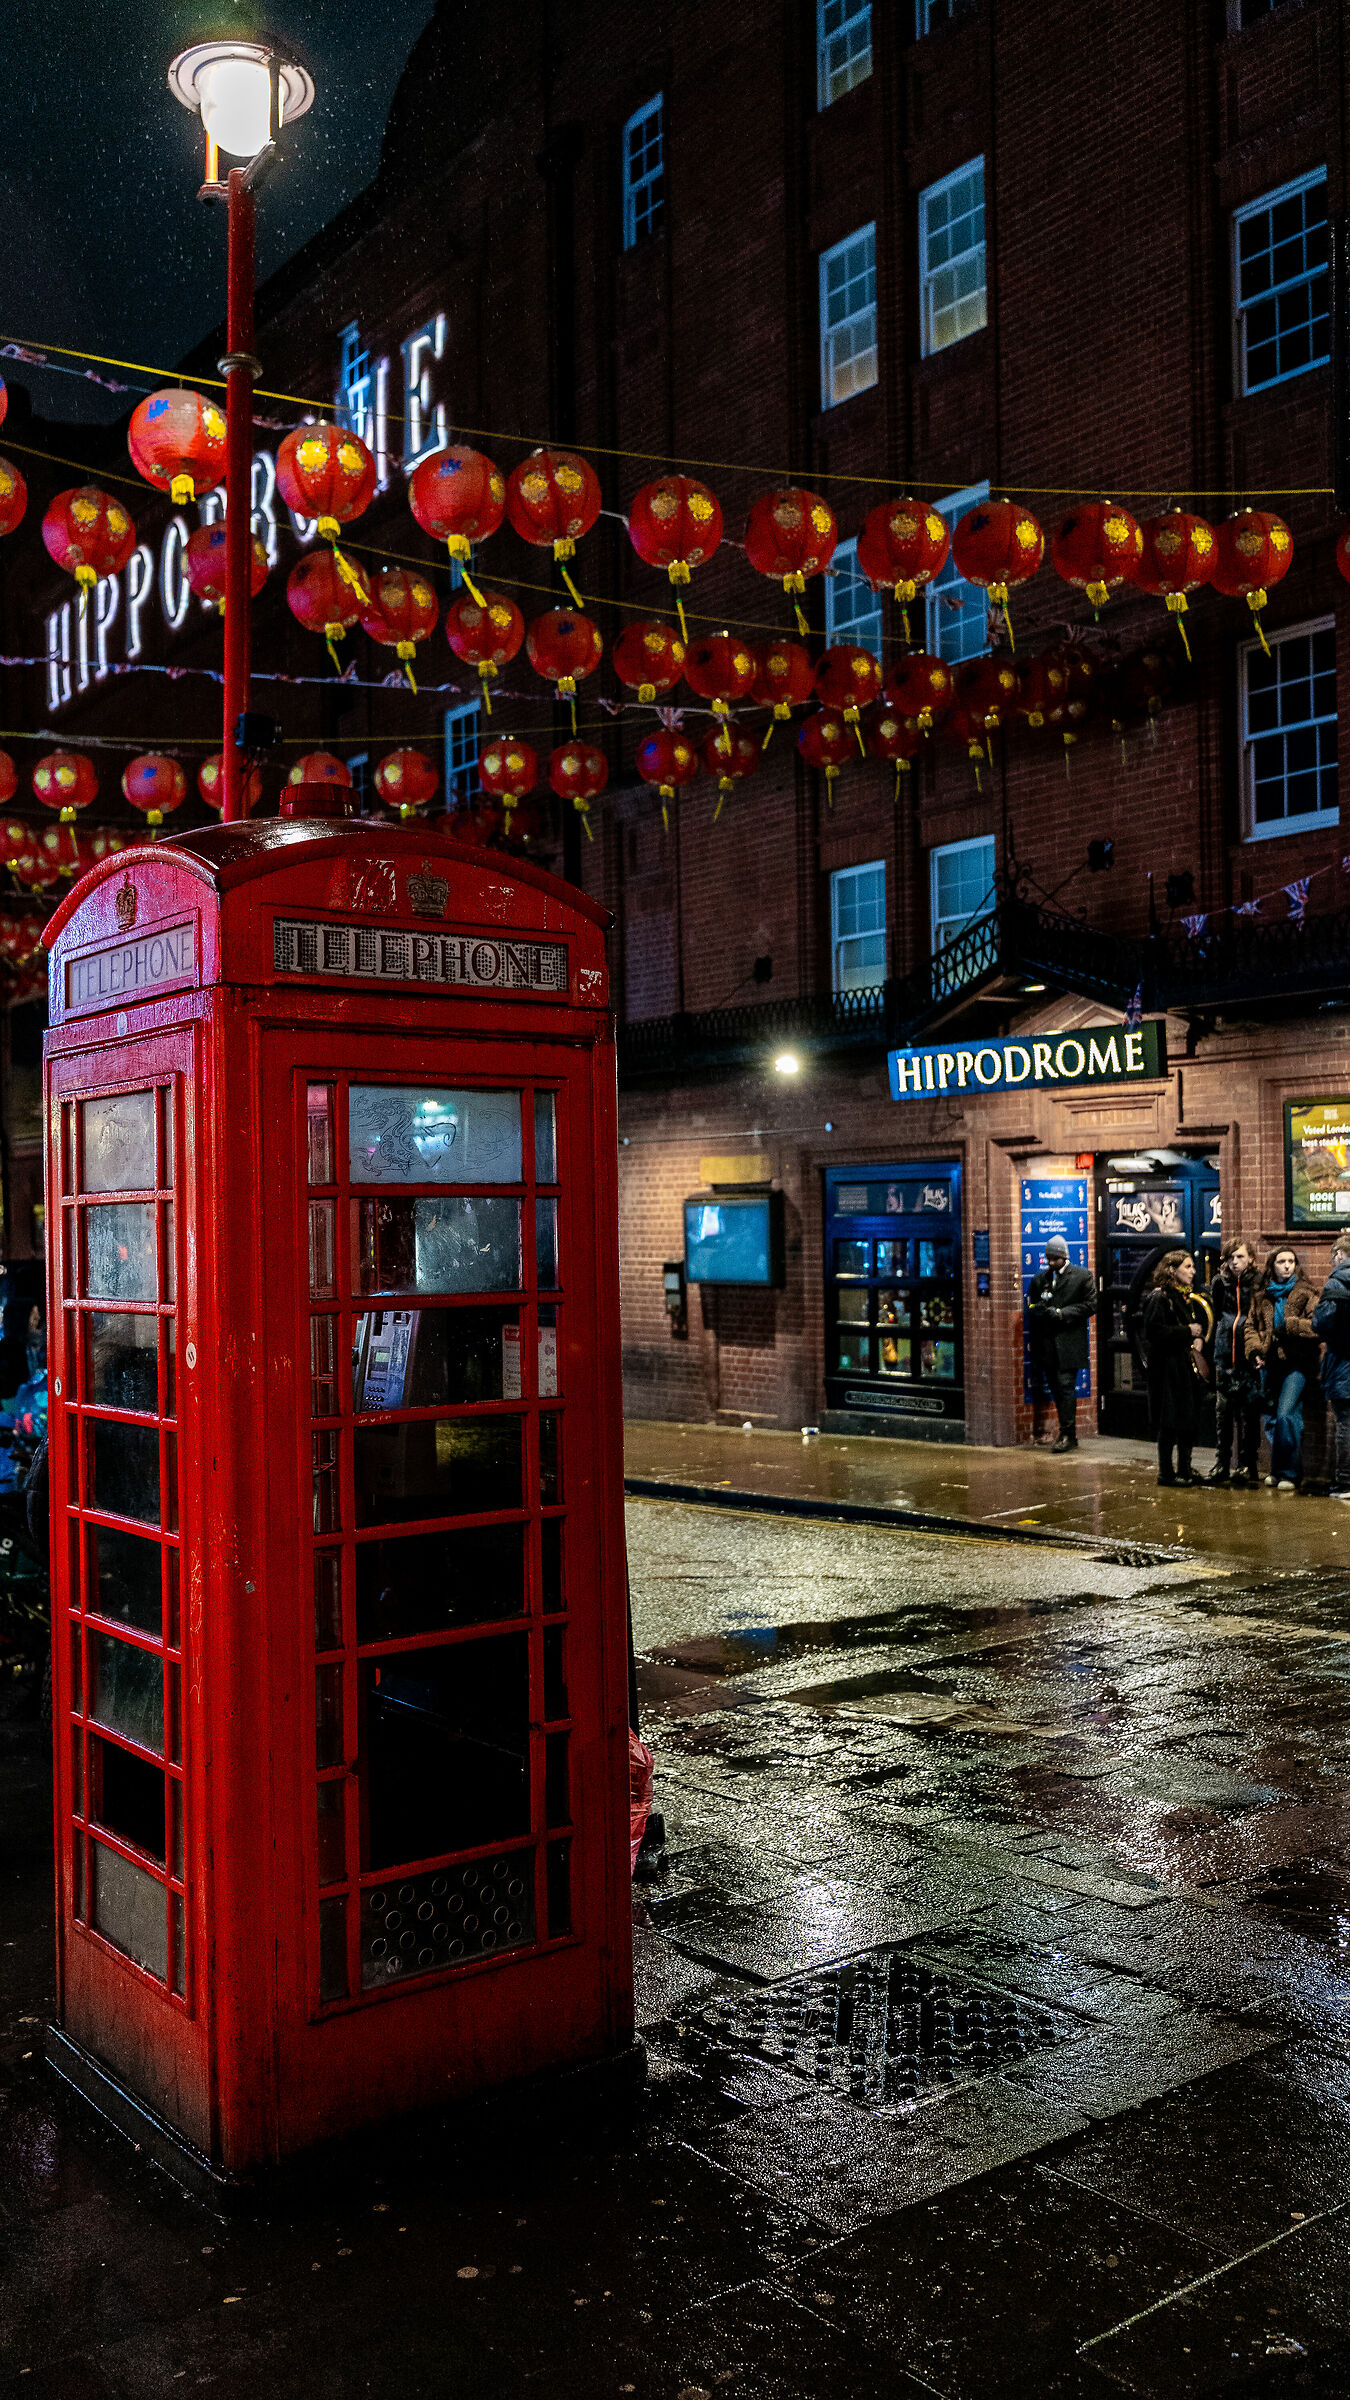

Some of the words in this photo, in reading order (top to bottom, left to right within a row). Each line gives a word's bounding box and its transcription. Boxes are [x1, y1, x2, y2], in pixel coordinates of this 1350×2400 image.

[45, 313, 448, 712] HIPPORME
[288, 926, 556, 986] TELEPHONE
[73, 930, 194, 1001] TELEPHONE
[897, 1030, 1146, 1093] HIPPODROME
[1303, 1124, 1325, 1135] Voted
[1302, 1138, 1318, 1148] best
[1024, 1187, 1032, 1201] 5
[1309, 1192, 1335, 1202] BOOK
[1309, 1202, 1333, 1212] HERE
[1024, 1221, 1032, 1235] 4
